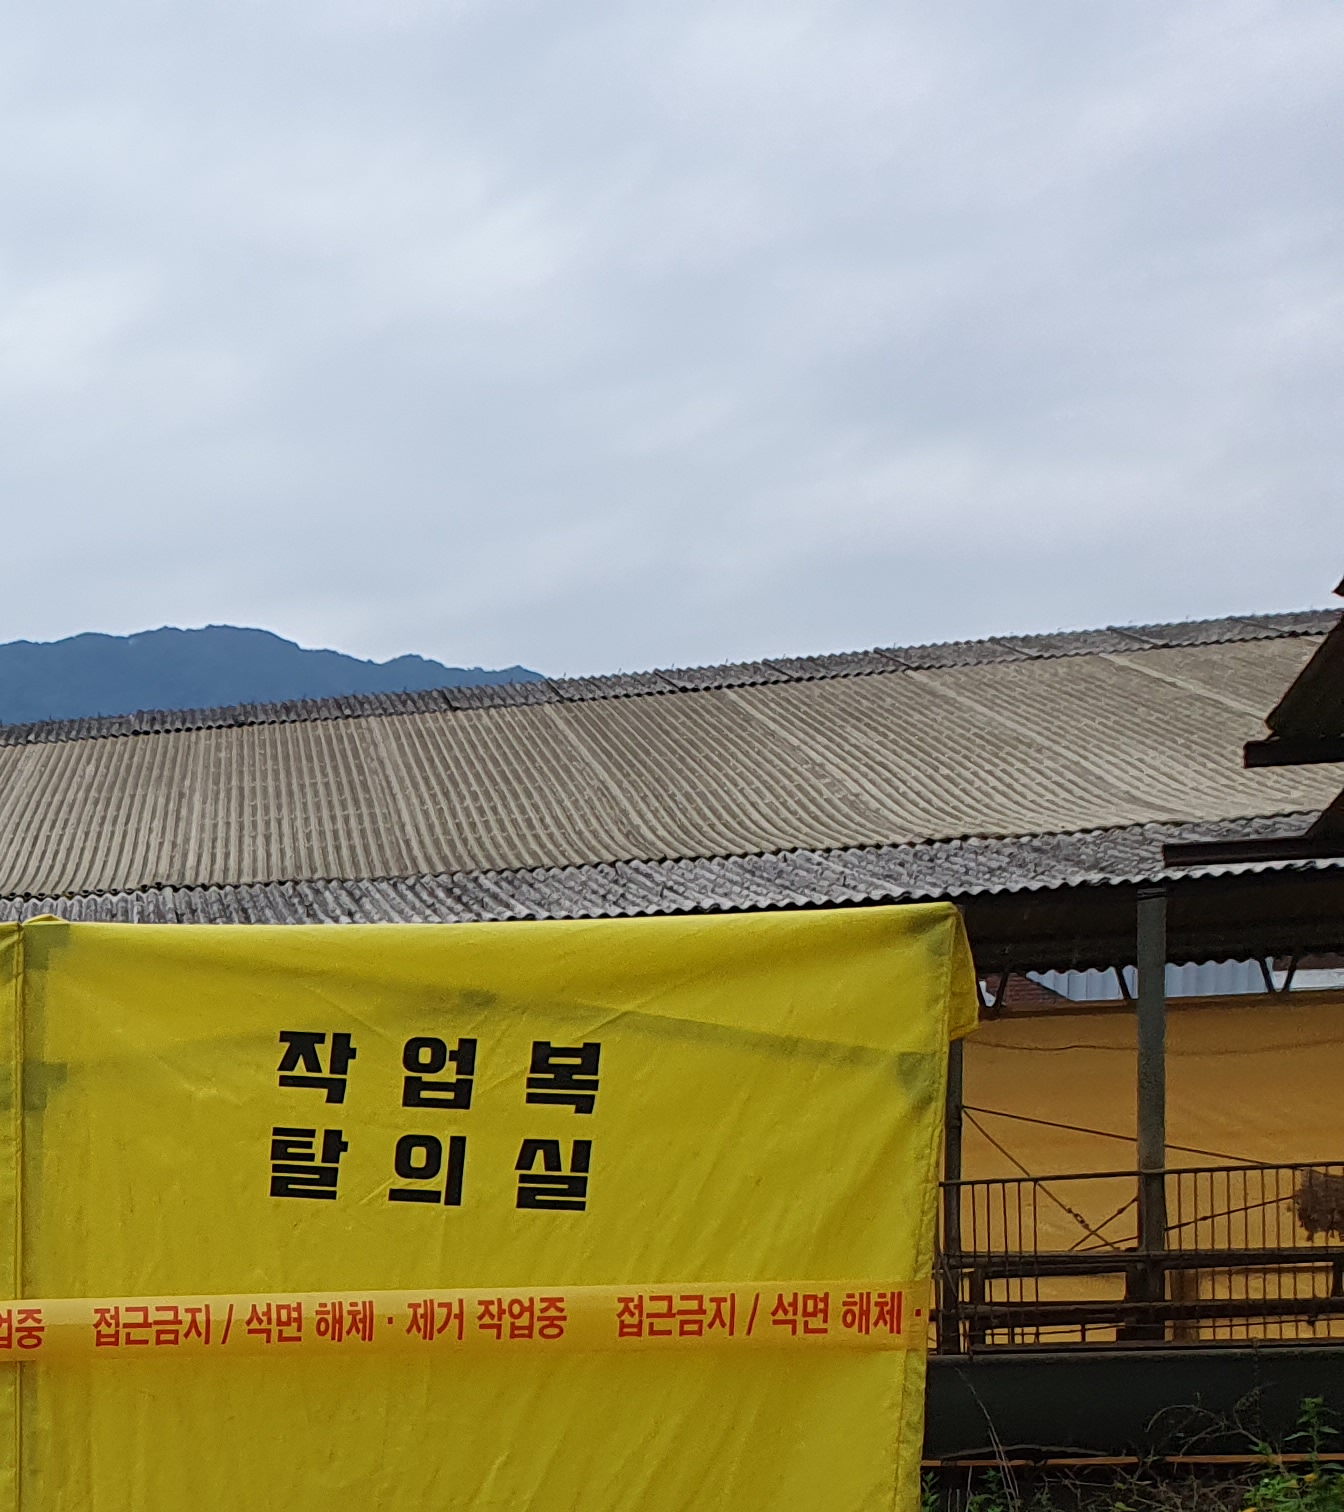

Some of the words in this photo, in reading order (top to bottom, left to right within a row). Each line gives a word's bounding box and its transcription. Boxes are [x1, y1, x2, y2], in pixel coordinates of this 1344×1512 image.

[95, 1306, 211, 1347] 접근금지
[247, 1304, 303, 1344] 석면
[316, 1302, 374, 1342] 해체
[407, 1300, 464, 1340] 제거
[479, 1298, 567, 1340] 작업중
[618, 1294, 736, 1338] 접근금지
[771, 1294, 829, 1335] 석면
[842, 1292, 903, 1334] 해체
